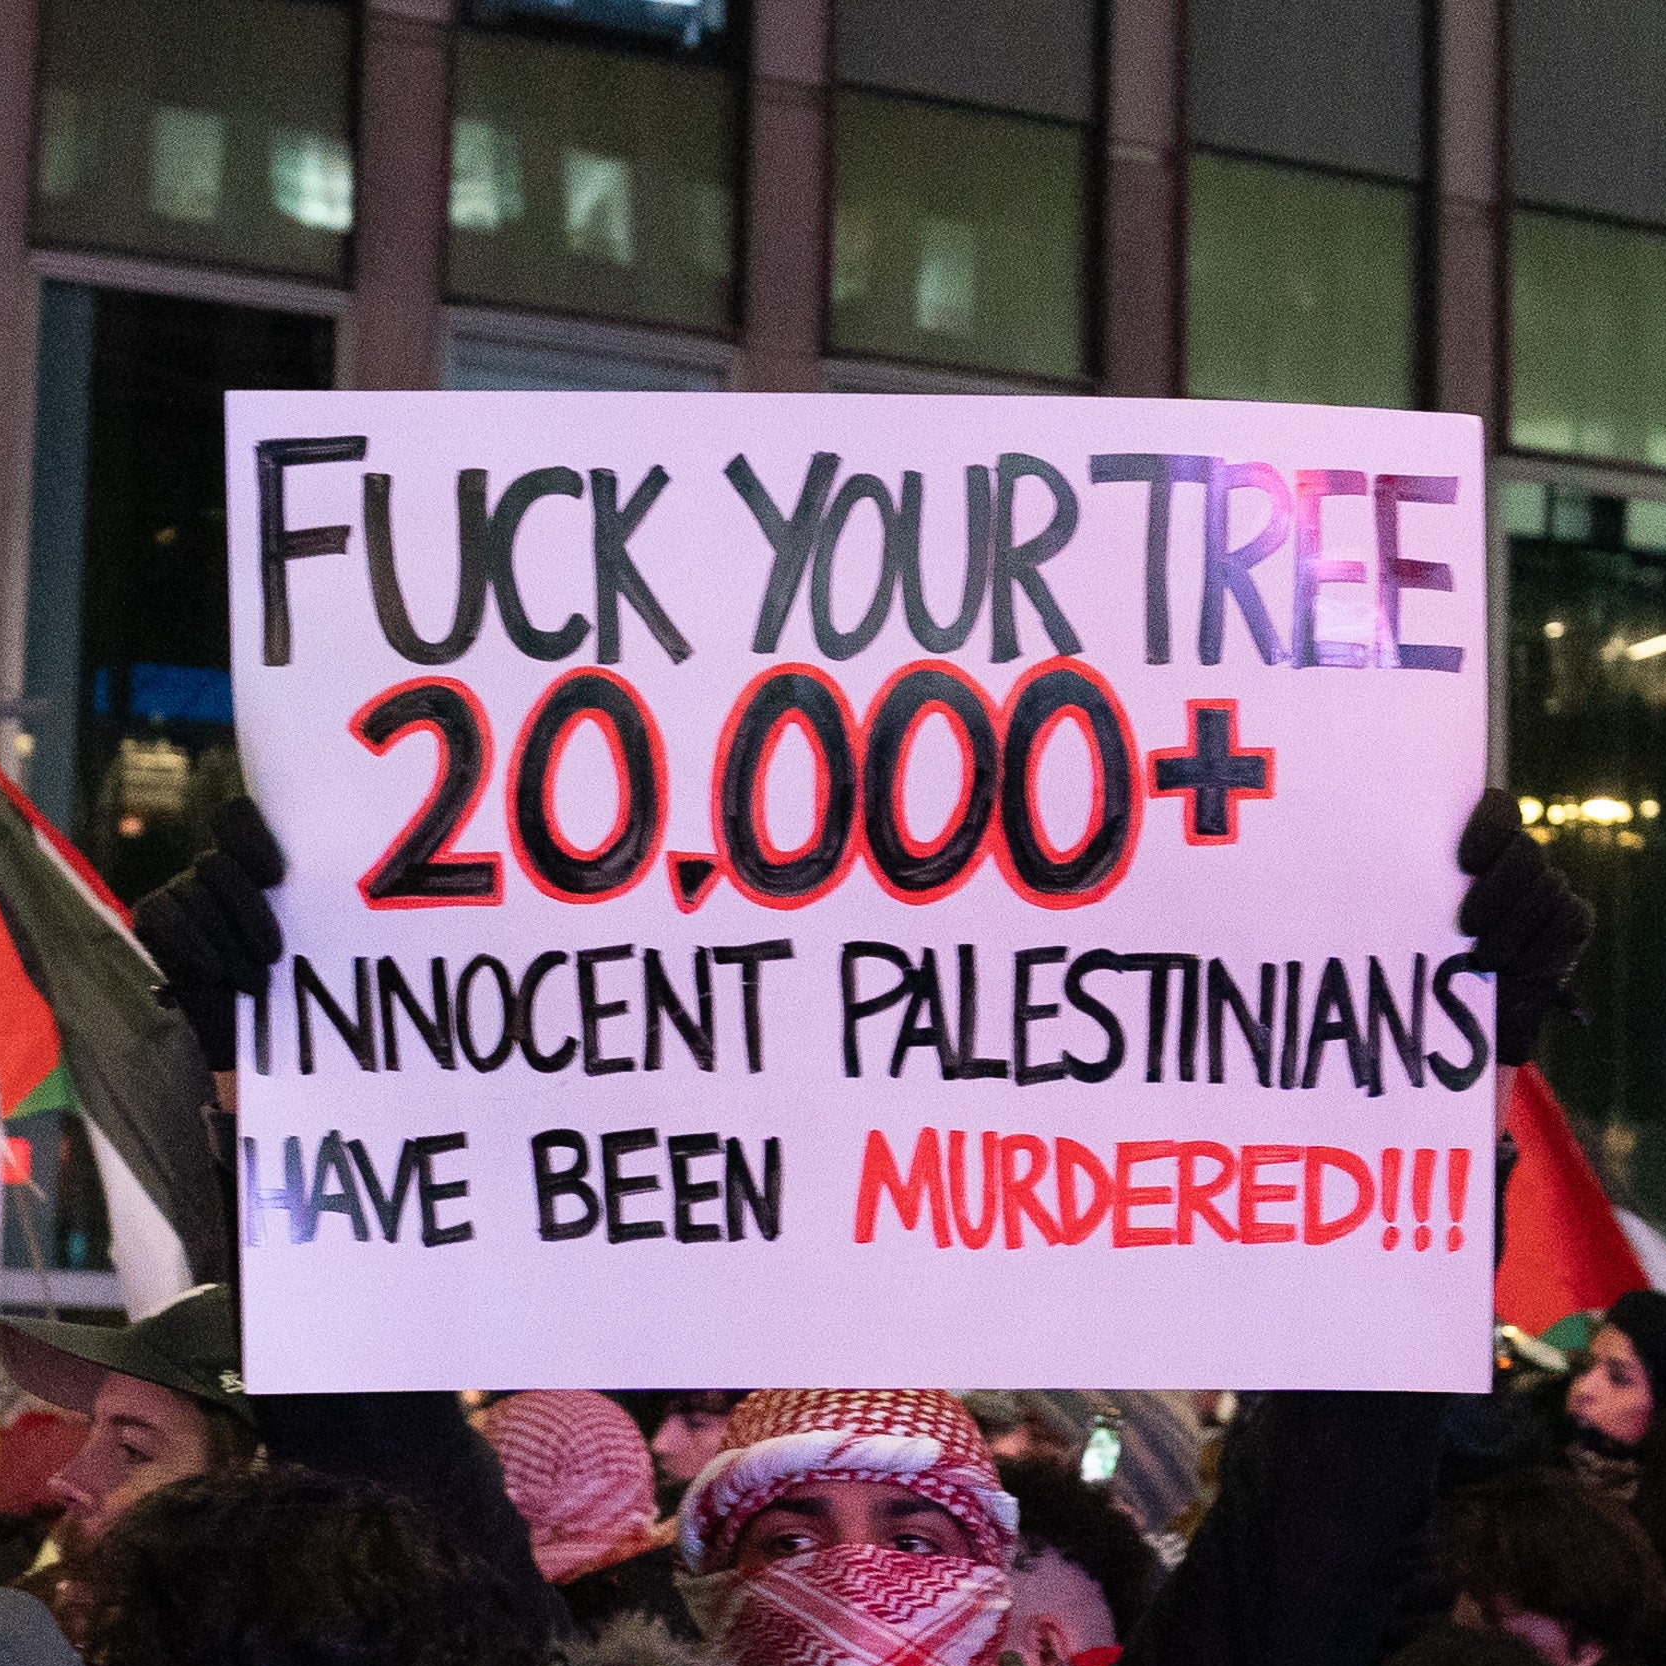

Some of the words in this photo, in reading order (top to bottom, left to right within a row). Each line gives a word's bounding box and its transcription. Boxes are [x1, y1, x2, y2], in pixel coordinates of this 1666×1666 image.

[254, 436, 693, 667] FUCK
[723, 451, 1083, 662] YOUR
[1089, 453, 1464, 673] TREE
[254, 939, 794, 1076] INNOCENT
[839, 940, 1489, 1096] PALESTINIANS
[242, 1129, 476, 1248] HAVE
[534, 1127, 780, 1243] BEEN
[854, 1127, 1472, 1252] MURDERED!!!
